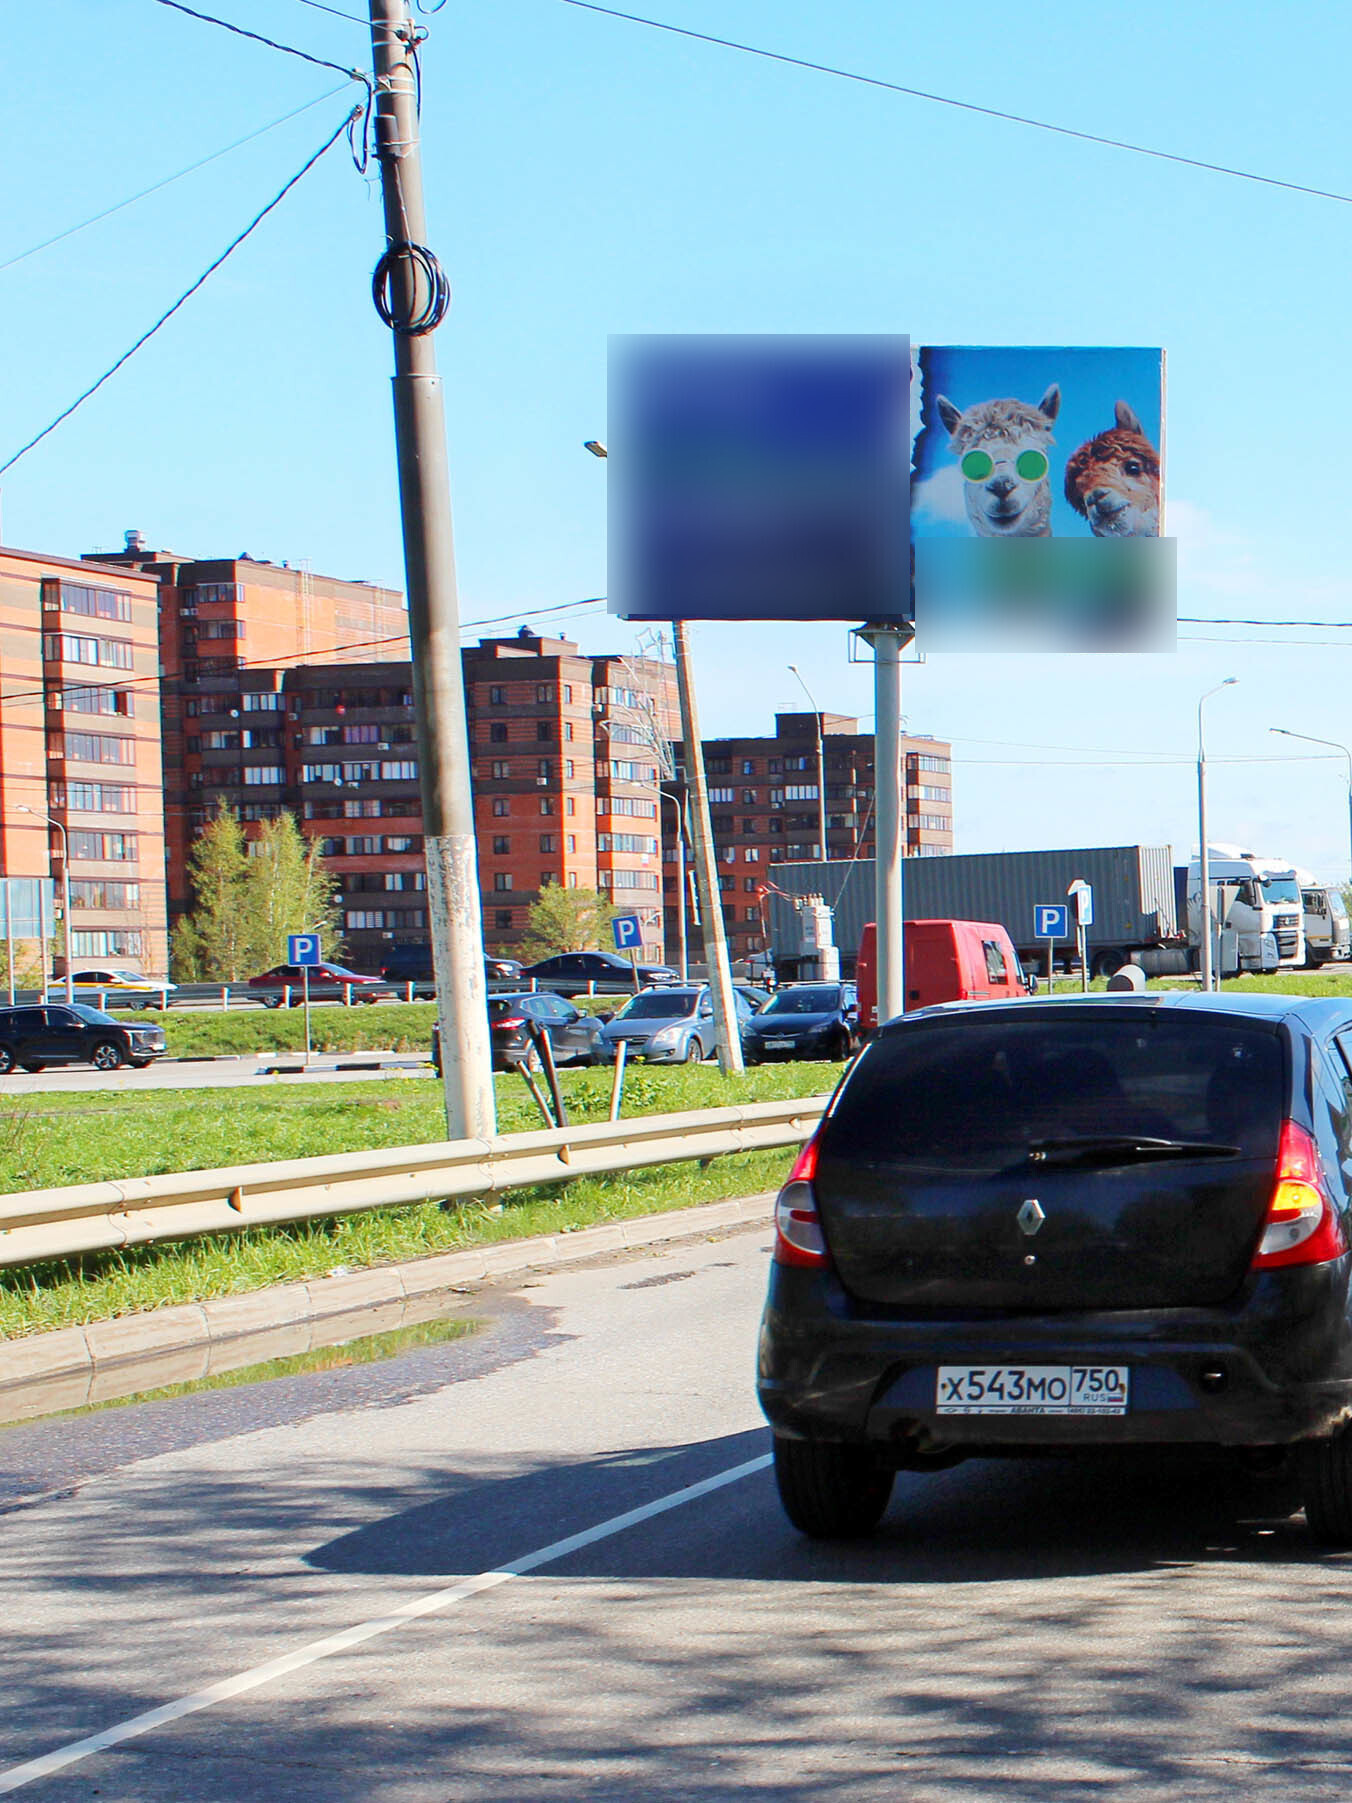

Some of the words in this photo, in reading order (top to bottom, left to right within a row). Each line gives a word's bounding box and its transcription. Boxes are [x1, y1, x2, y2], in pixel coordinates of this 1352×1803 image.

[618, 919, 635, 946] P
[1041, 908, 1060, 934] P
[294, 937, 313, 963] P
[1072, 1368, 1119, 1392] 750
[1083, 1393, 1106, 1402] RUS
